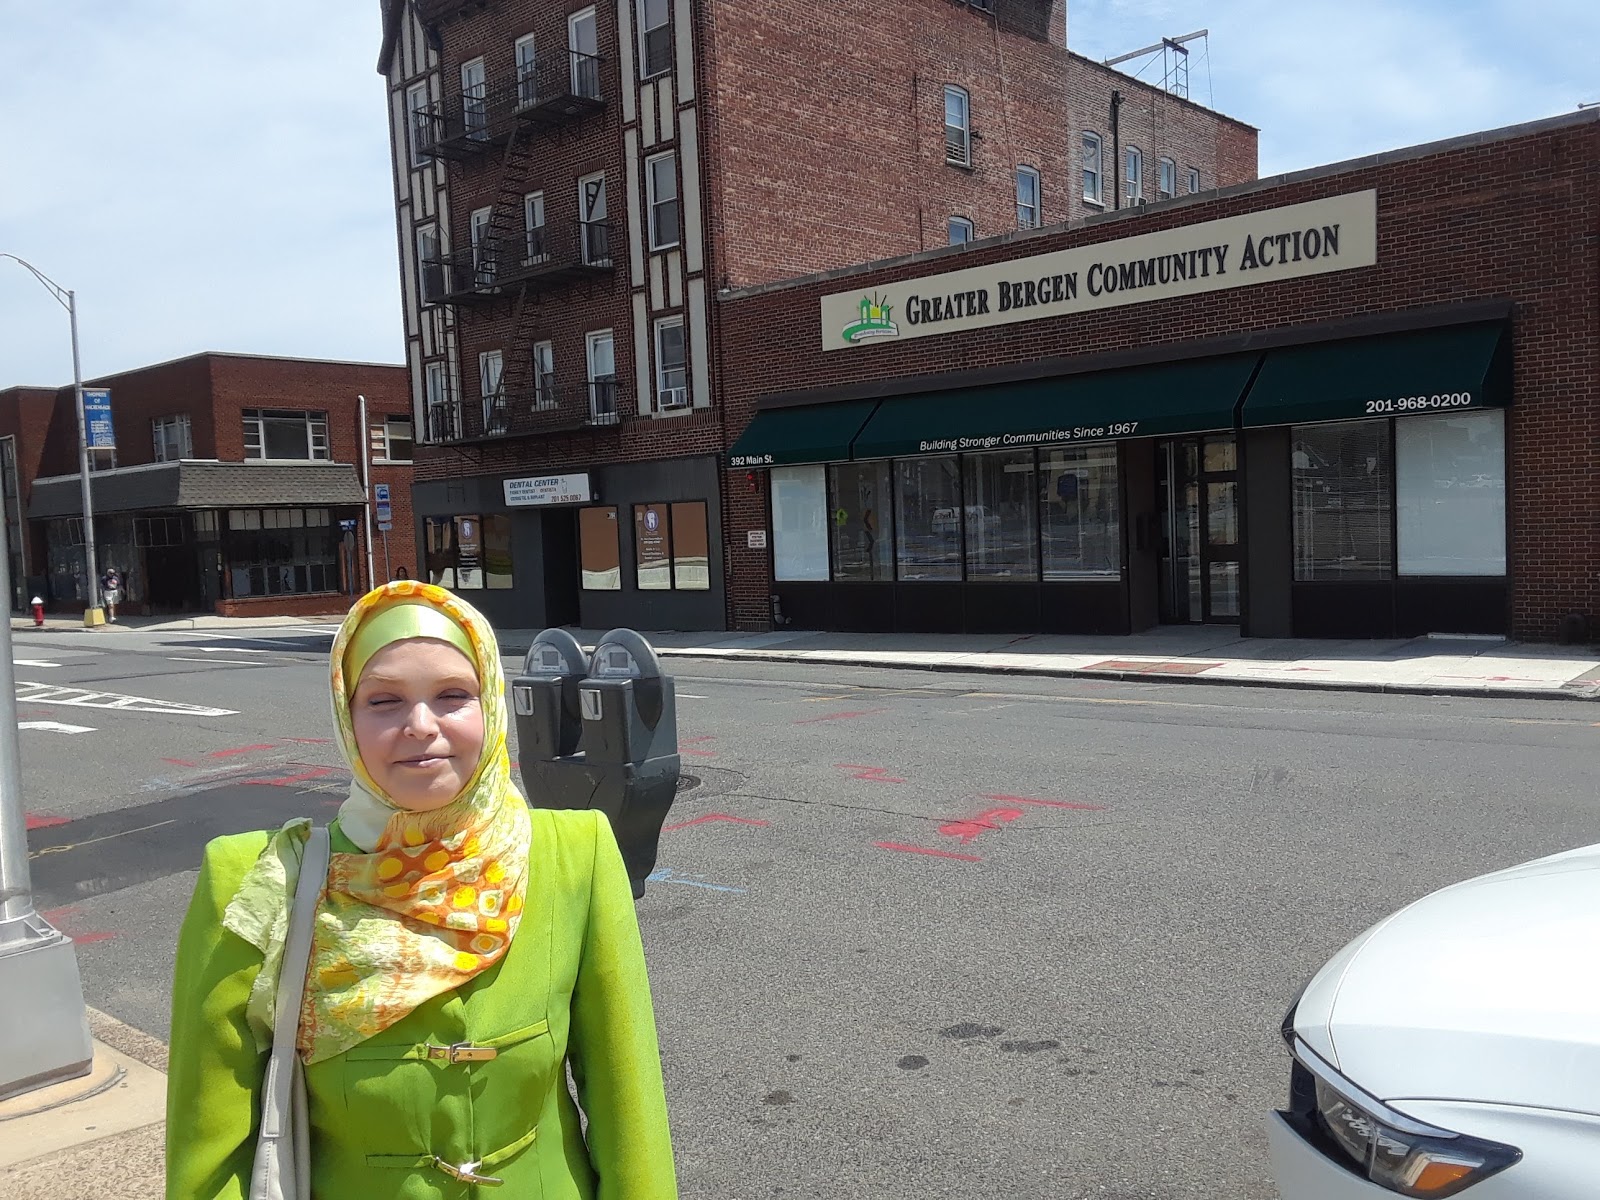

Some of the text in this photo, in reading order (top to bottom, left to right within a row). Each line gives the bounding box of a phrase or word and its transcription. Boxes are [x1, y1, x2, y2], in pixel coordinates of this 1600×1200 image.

[905, 224, 1341, 325] GREATER BERGEN COMMUNITY ACTION
[1365, 392, 1471, 413] 201-968-0200
[919, 422, 1138, 451] Building Stronger Communities Since 1967
[730, 454, 774, 466] 392 Main St.
[509, 478, 559, 489] DENTAL CENTER
